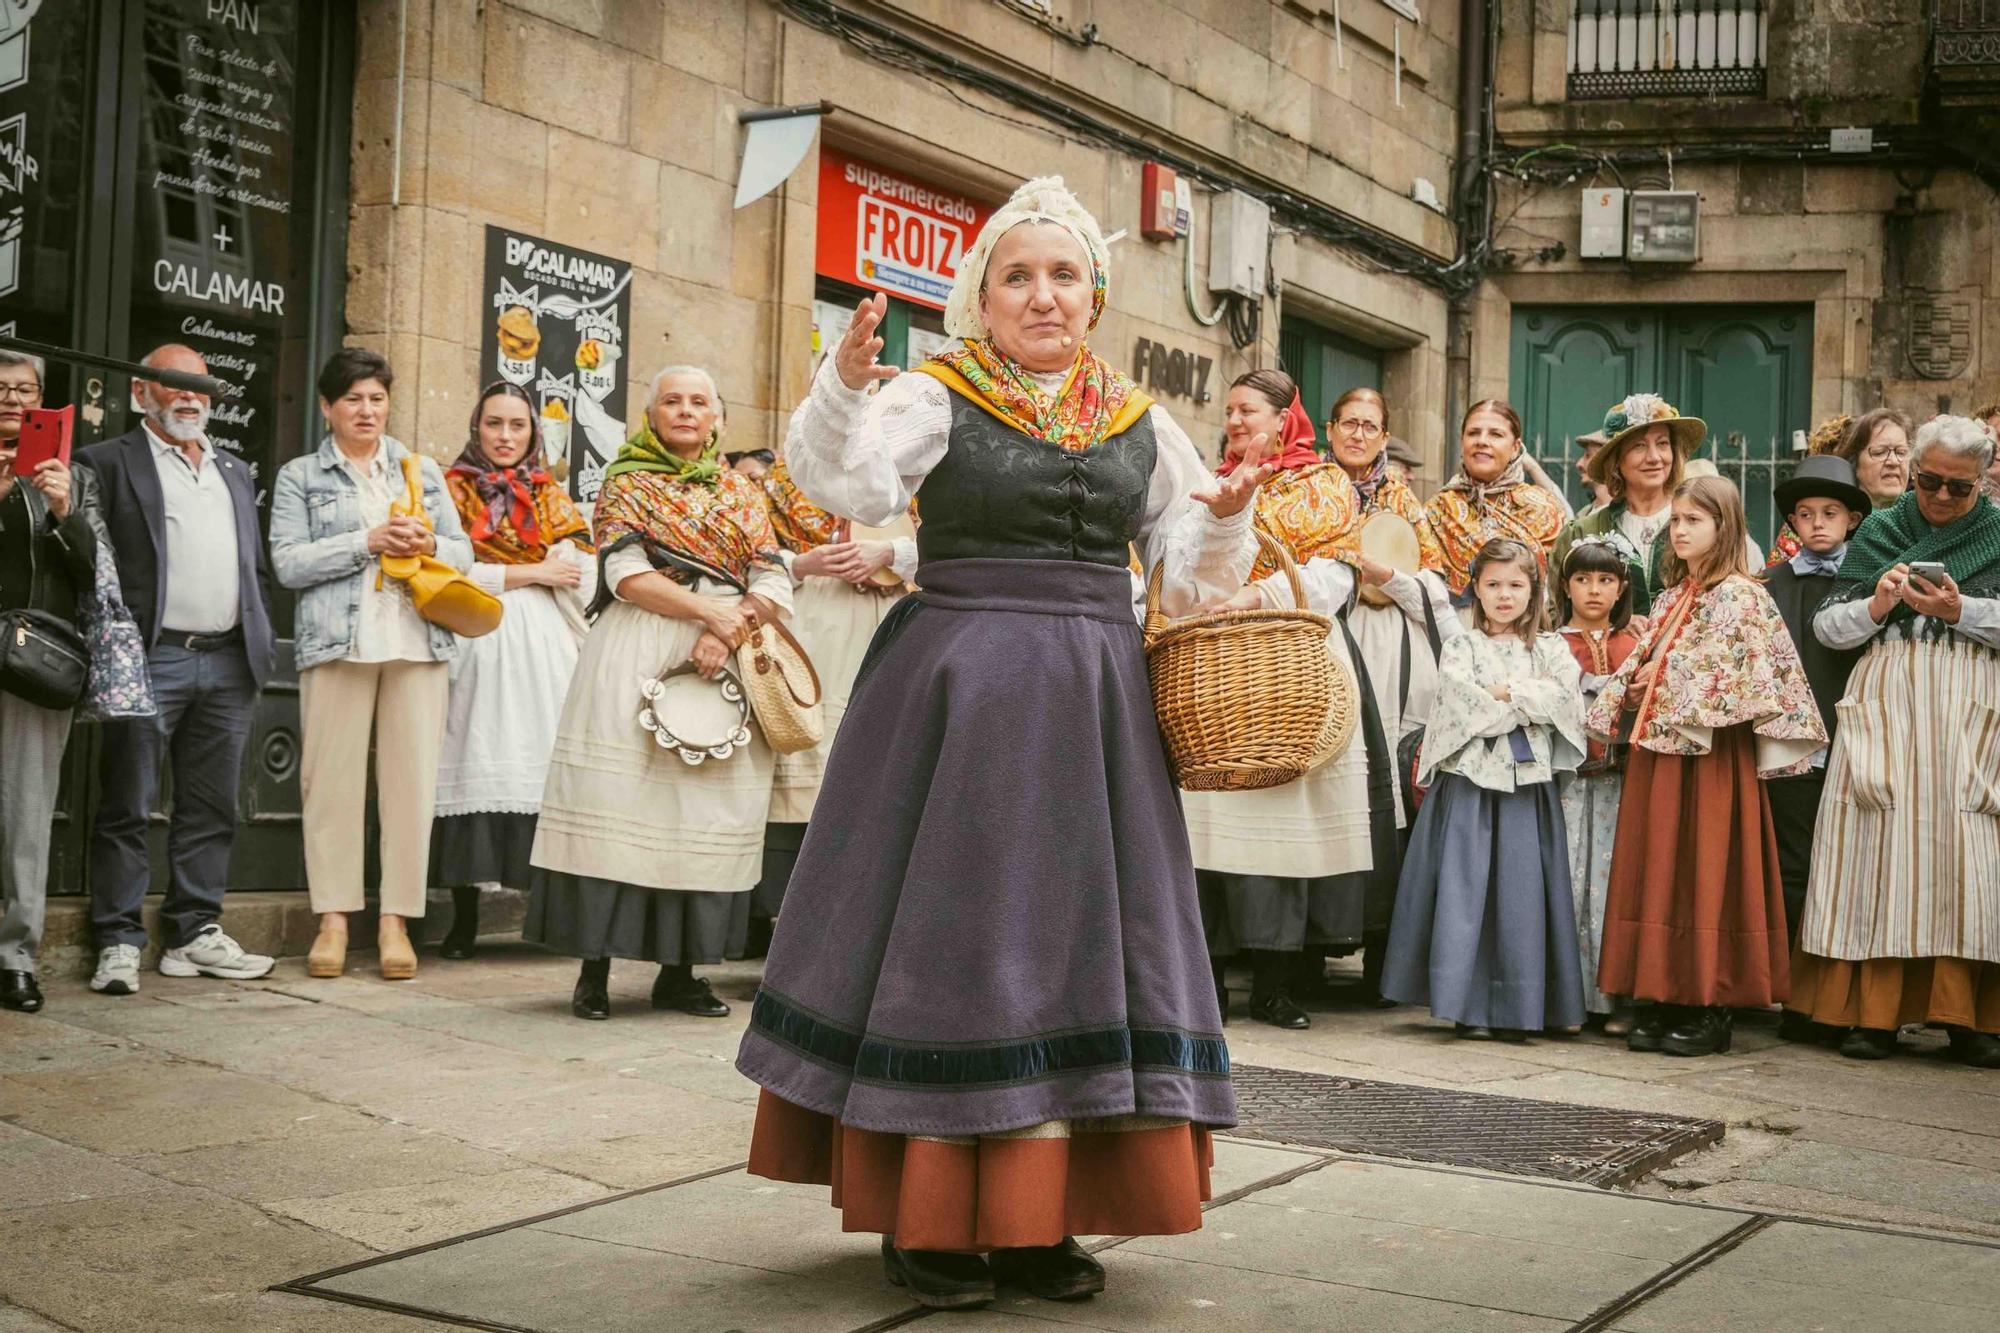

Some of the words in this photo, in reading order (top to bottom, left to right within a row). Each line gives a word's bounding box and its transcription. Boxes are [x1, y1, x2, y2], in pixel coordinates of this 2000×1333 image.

[207, 0, 259, 35] PAN
[187, 68, 226, 88] suave
[227, 81, 260, 104] miga
[262, 92, 273, 110] y
[190, 147, 238, 173] Hecho
[236, 165, 261, 182] por
[844, 164, 976, 224] supermercado
[863, 202, 958, 279] FROIZ
[154, 259, 285, 315] CALAMAR
[181, 315, 257, 347] Calamares
[1133, 336, 1213, 404] FROIZ
